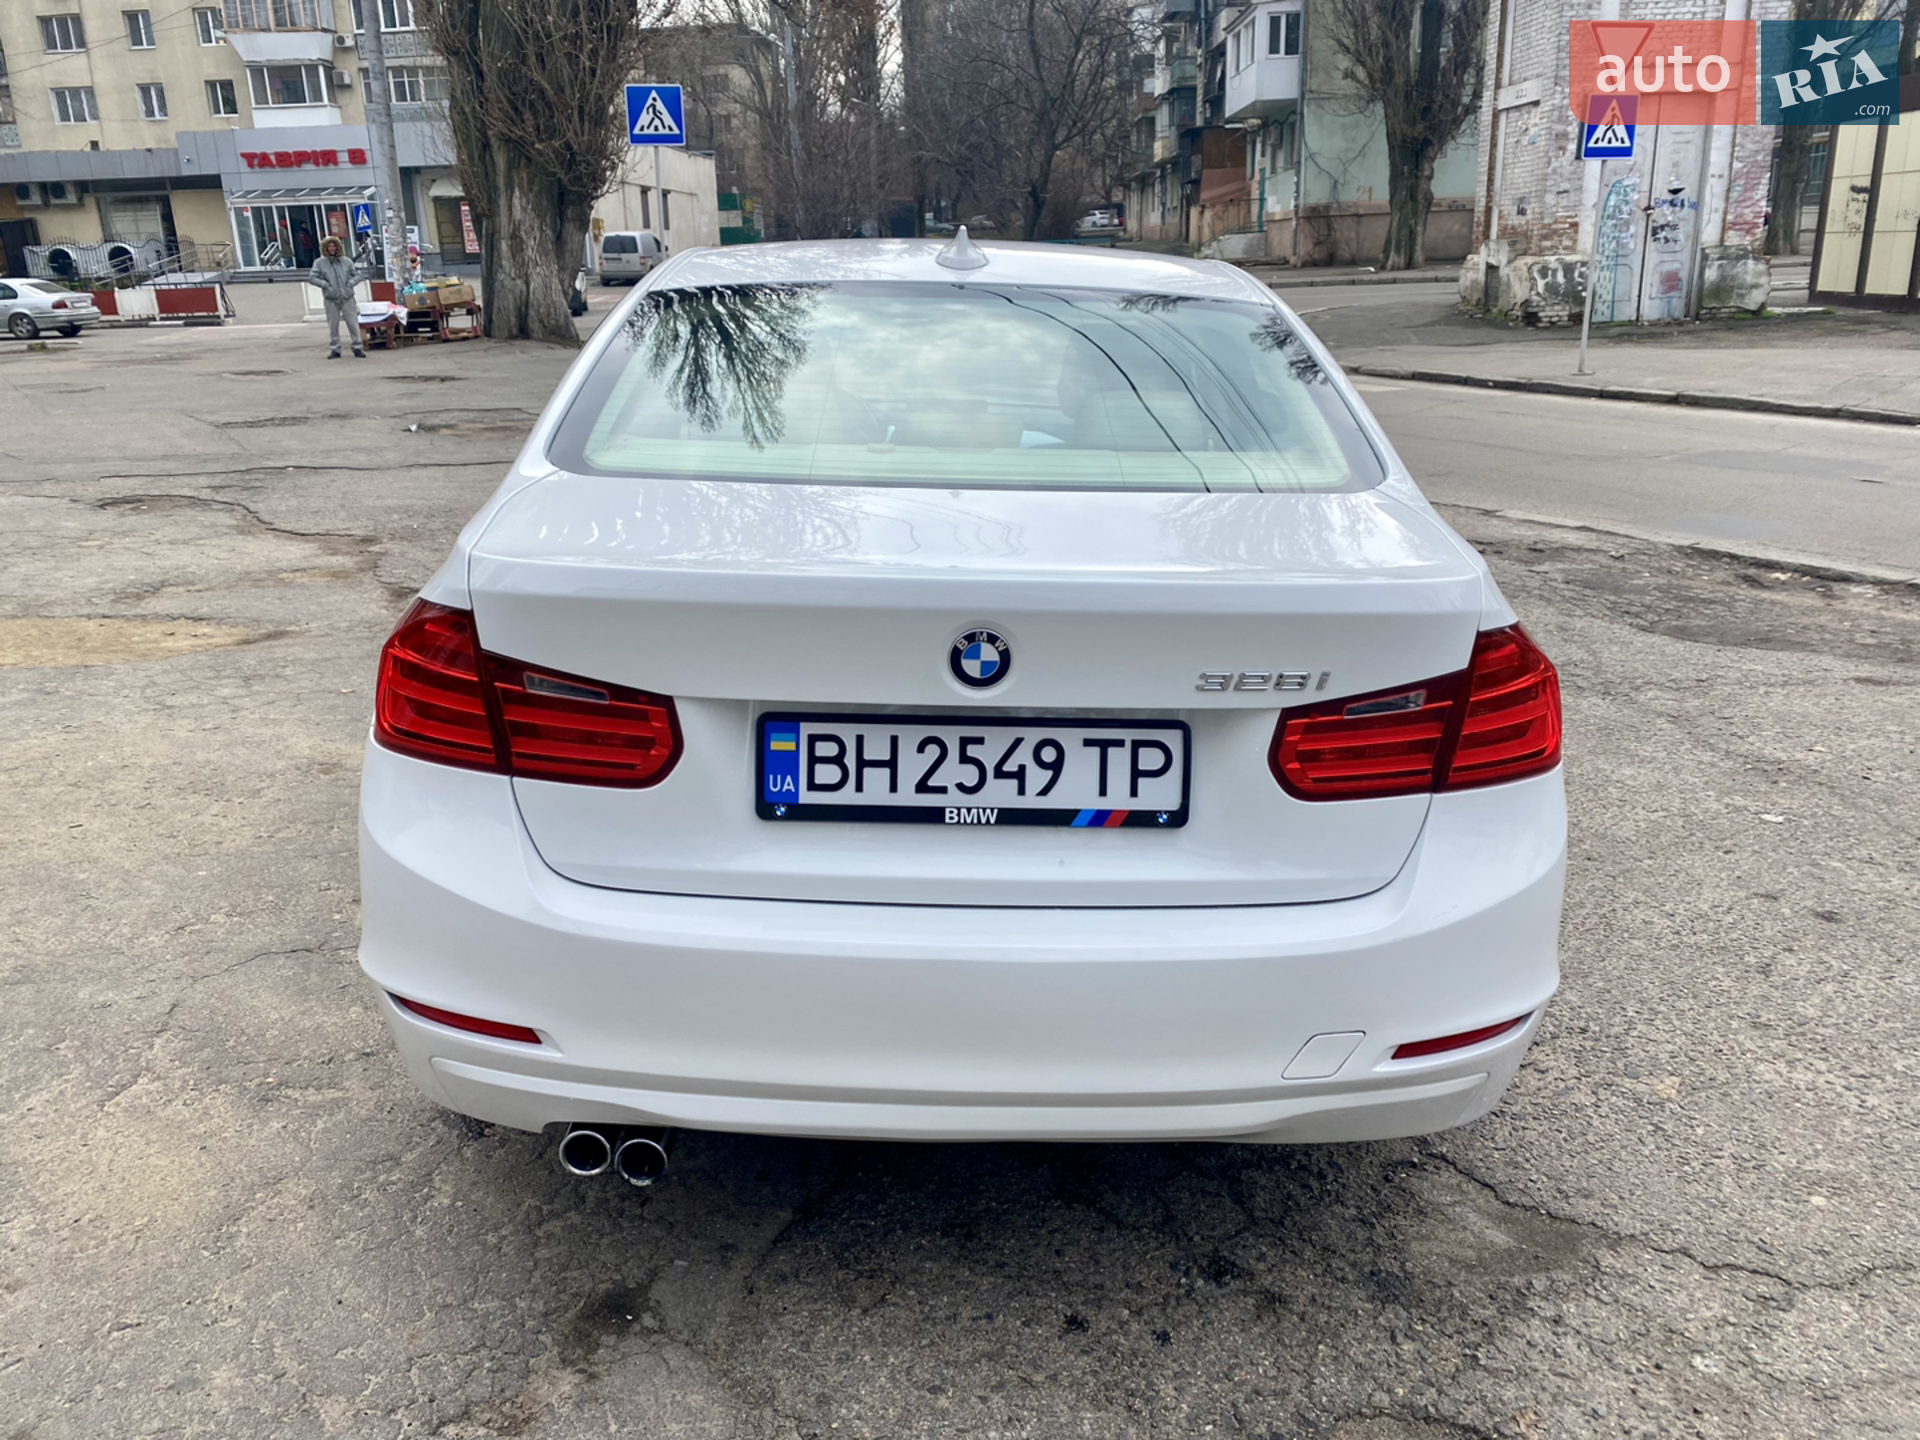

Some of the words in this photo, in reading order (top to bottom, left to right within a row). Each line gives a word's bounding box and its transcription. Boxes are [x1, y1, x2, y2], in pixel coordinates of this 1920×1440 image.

[240, 149, 339, 169] ТАВРІЯ
[347, 148, 368, 166] В
[955, 631, 1008, 652] BMW
[1195, 671, 1332, 691] 328i
[806, 733, 899, 793] BH
[914, 735, 1066, 797] 2549
[1082, 738, 1174, 798] TP
[768, 774, 796, 793] UA
[944, 807, 999, 825] BMW
